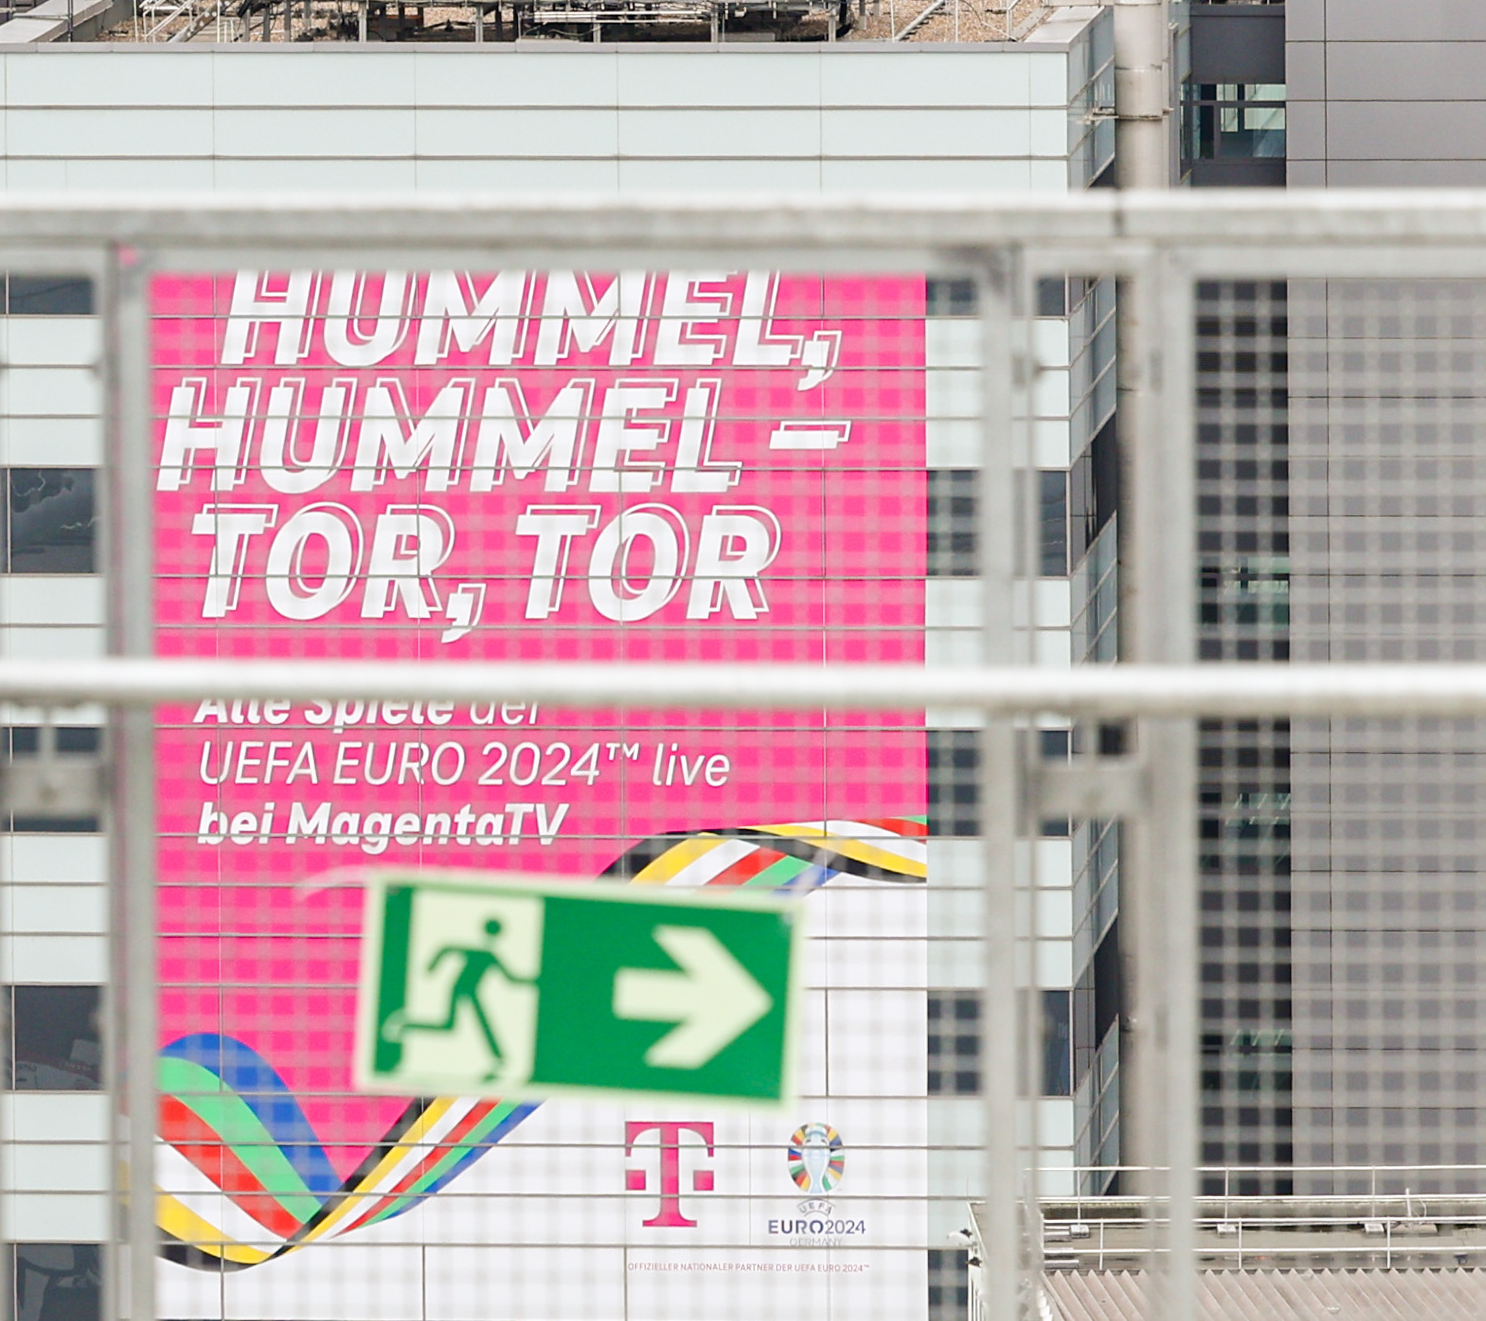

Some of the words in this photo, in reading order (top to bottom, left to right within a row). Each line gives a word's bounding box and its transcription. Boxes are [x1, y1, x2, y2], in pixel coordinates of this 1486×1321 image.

[221, 270, 842, 391] HUMMEL,
[156, 376, 743, 494] HUMMEL
[190, 503, 487, 643] TOR,
[514, 503, 782, 621] TOR
[192, 699, 292, 725] Alle
[304, 699, 454, 734] Spiele
[199, 740, 319, 785] UEFA
[332, 740, 466, 786] EURO
[652, 742, 731, 787] live
[196, 801, 276, 846] bei
[285, 802, 571, 856] MagentaTV
[799, 1201, 834, 1216] UEFA
[789, 1237, 844, 1247] GERMANY
[627, 1262, 679, 1271] OFFIZIELLER
[680, 1262, 735, 1272] NATIONALER
[735, 1263, 775, 1272] PARTNER
[776, 1263, 793, 1272] DER
[794, 1264, 816, 1272] UEFA
[817, 1264, 841, 1272] EURO
